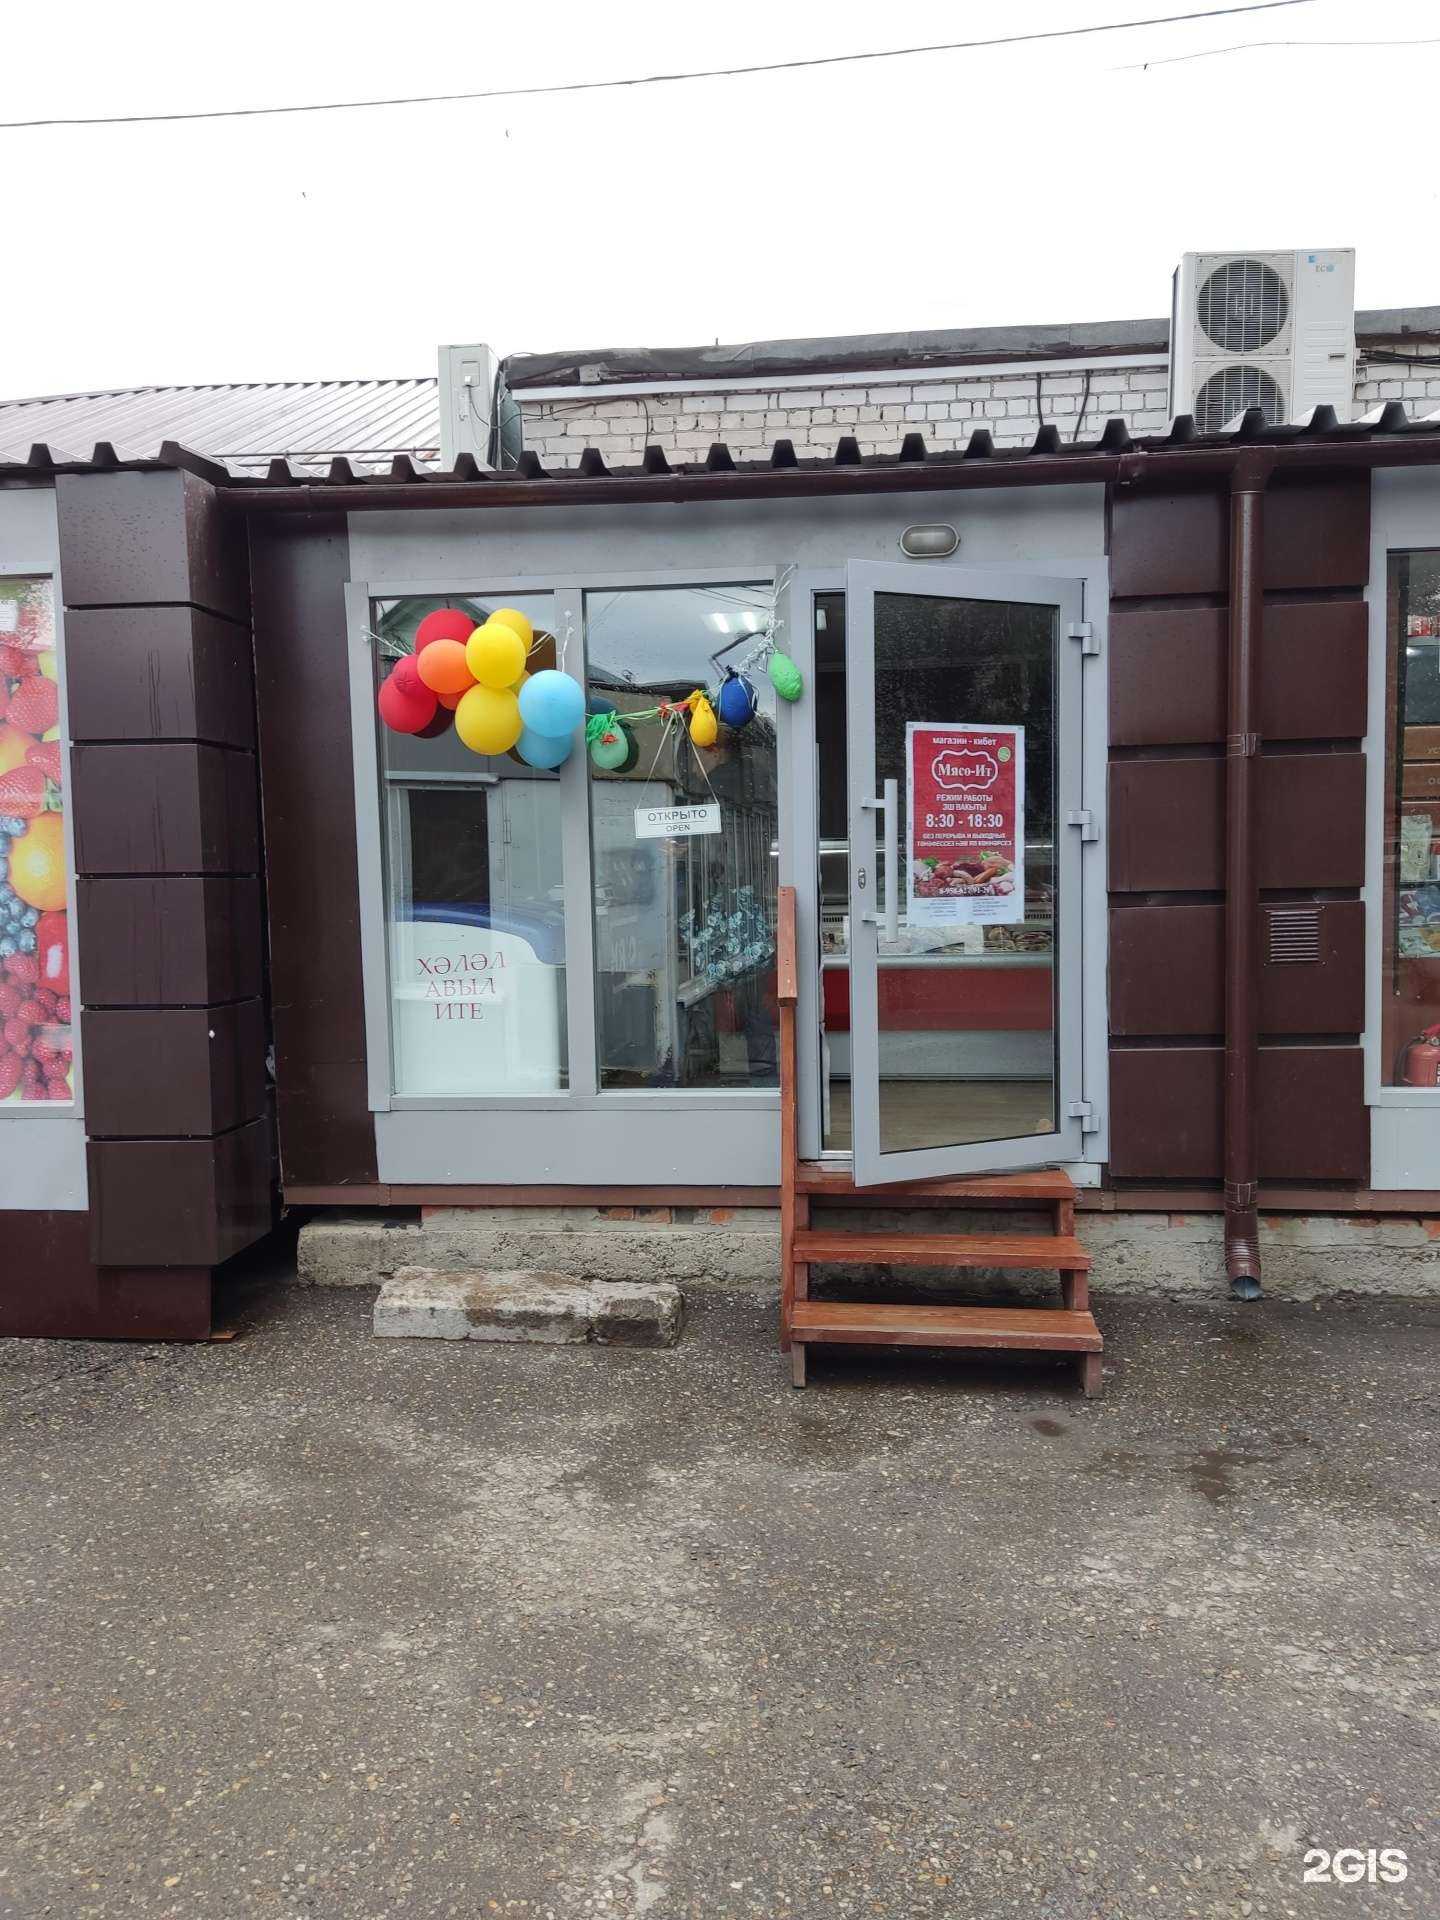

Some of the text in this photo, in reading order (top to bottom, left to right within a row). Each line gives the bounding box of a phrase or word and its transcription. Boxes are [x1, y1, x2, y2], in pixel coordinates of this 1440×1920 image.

[932, 737, 967, 745] магазин
[973, 736, 998, 746] кибет
[937, 763, 993, 777] Мясо-Ит
[936, 794, 993, 802] РЕЖИМ РАБОТЫ
[956, 803, 987, 811] ВАКЫТЫ
[648, 809, 707, 821] ОТКРЫТО
[925, 813, 955, 828] 8:30
[967, 813, 1004, 828] 18:30
[665, 823, 691, 832] OPEN
[416, 951, 505, 975] ХӘЛӘЛ
[425, 977, 496, 998] АВЫЛ
[433, 1002, 484, 1020] ИТЕ
